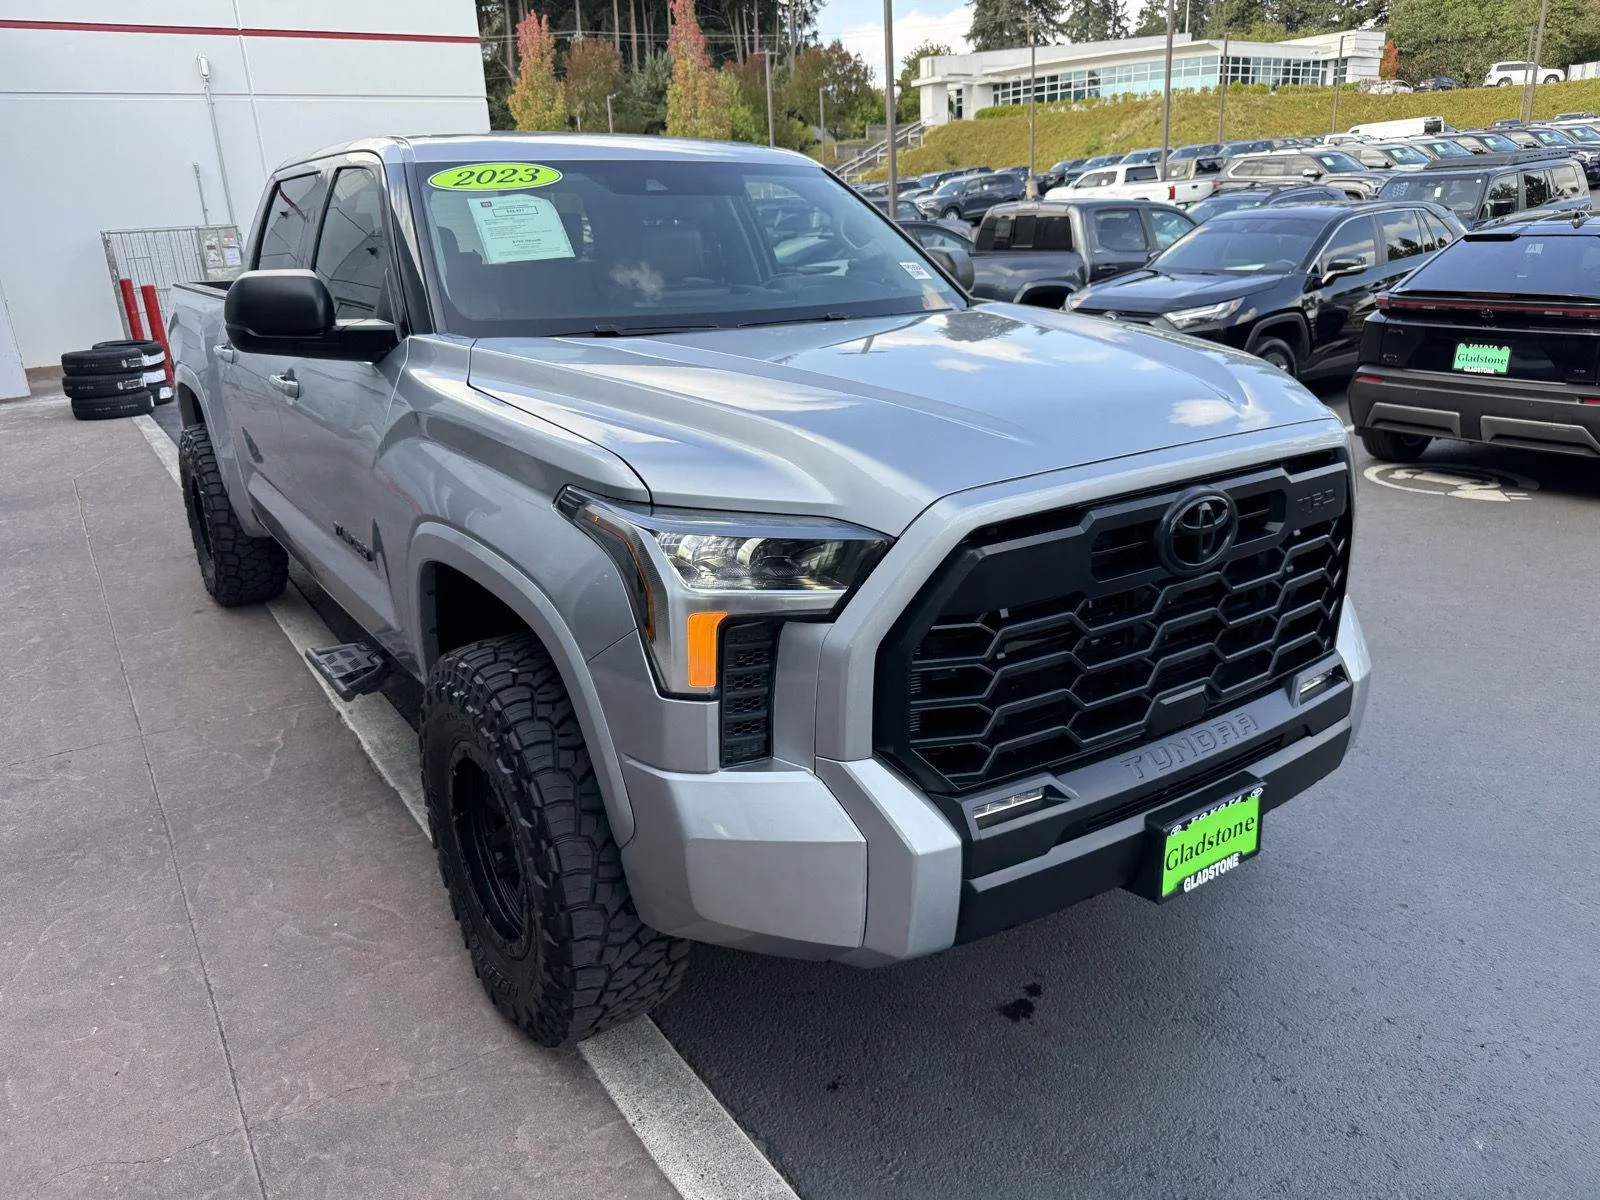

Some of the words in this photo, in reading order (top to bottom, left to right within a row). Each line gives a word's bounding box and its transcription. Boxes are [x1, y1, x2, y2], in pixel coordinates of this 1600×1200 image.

[453, 167, 540, 187] 2023
[1457, 353, 1507, 365] Gladstone
[1120, 712, 1259, 779] TUNDRA
[1165, 816, 1255, 872] Gladstone
[1183, 852, 1240, 893] GLADSTONE
